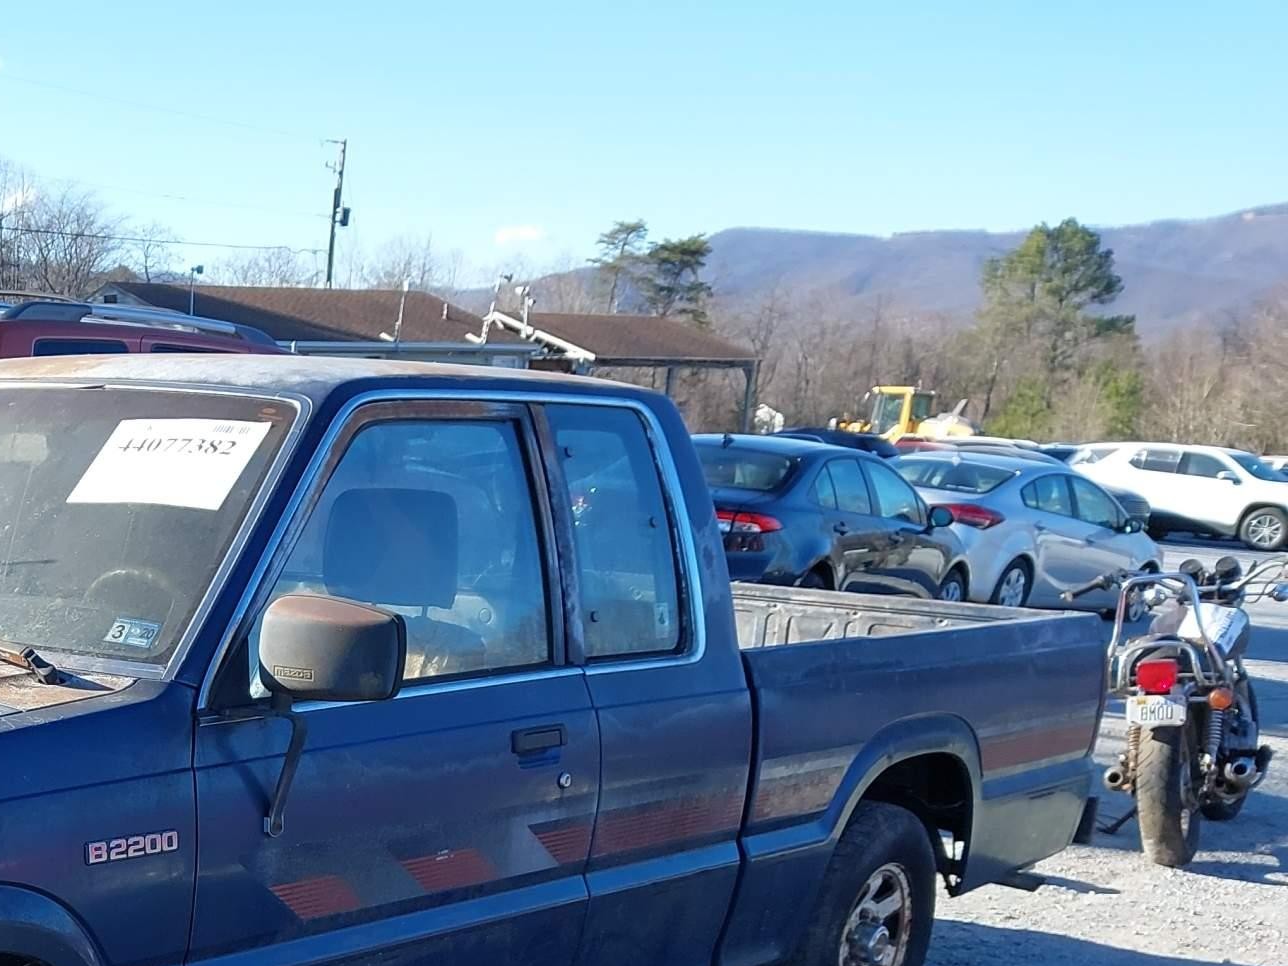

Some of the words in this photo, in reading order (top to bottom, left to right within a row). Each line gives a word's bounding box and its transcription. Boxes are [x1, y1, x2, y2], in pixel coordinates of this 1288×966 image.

[118, 438, 237, 455] 44077382
[111, 624, 126, 639] 3
[88, 831, 178, 864] B2200
